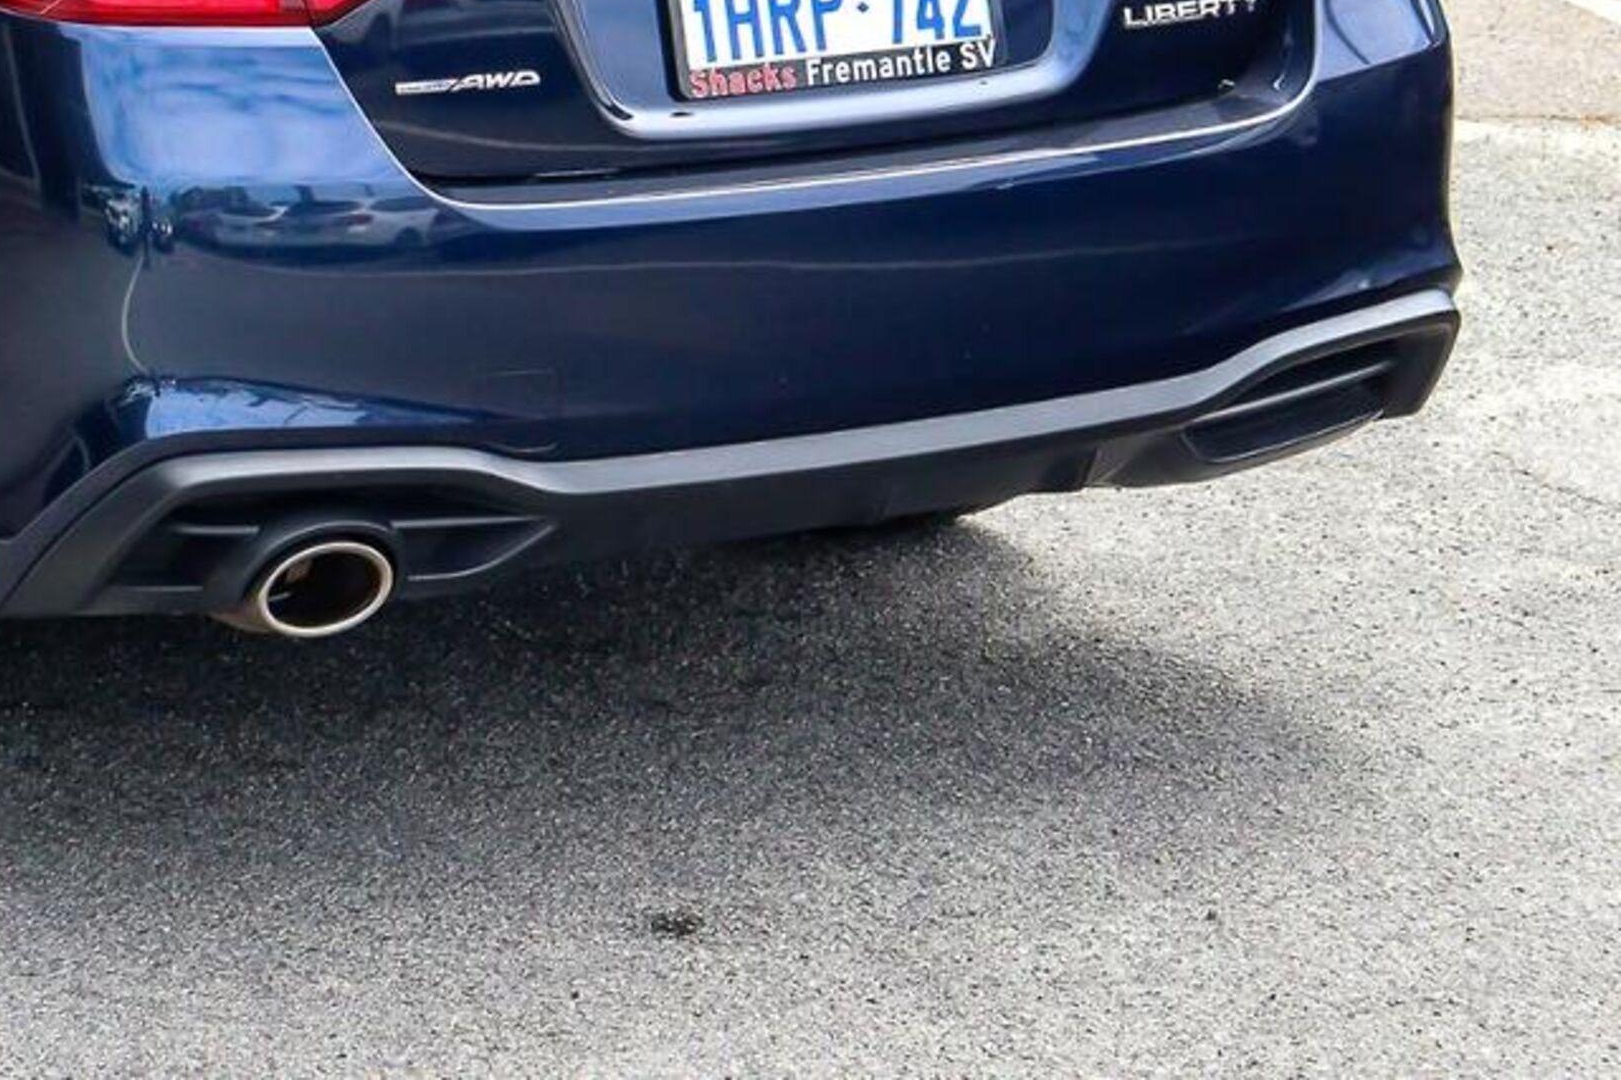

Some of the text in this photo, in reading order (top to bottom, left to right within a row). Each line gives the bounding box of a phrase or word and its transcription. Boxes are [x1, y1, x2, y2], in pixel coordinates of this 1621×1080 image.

[451, 70, 540, 93] AWD
[689, 39, 996, 99] Shacks Fremantle SV
